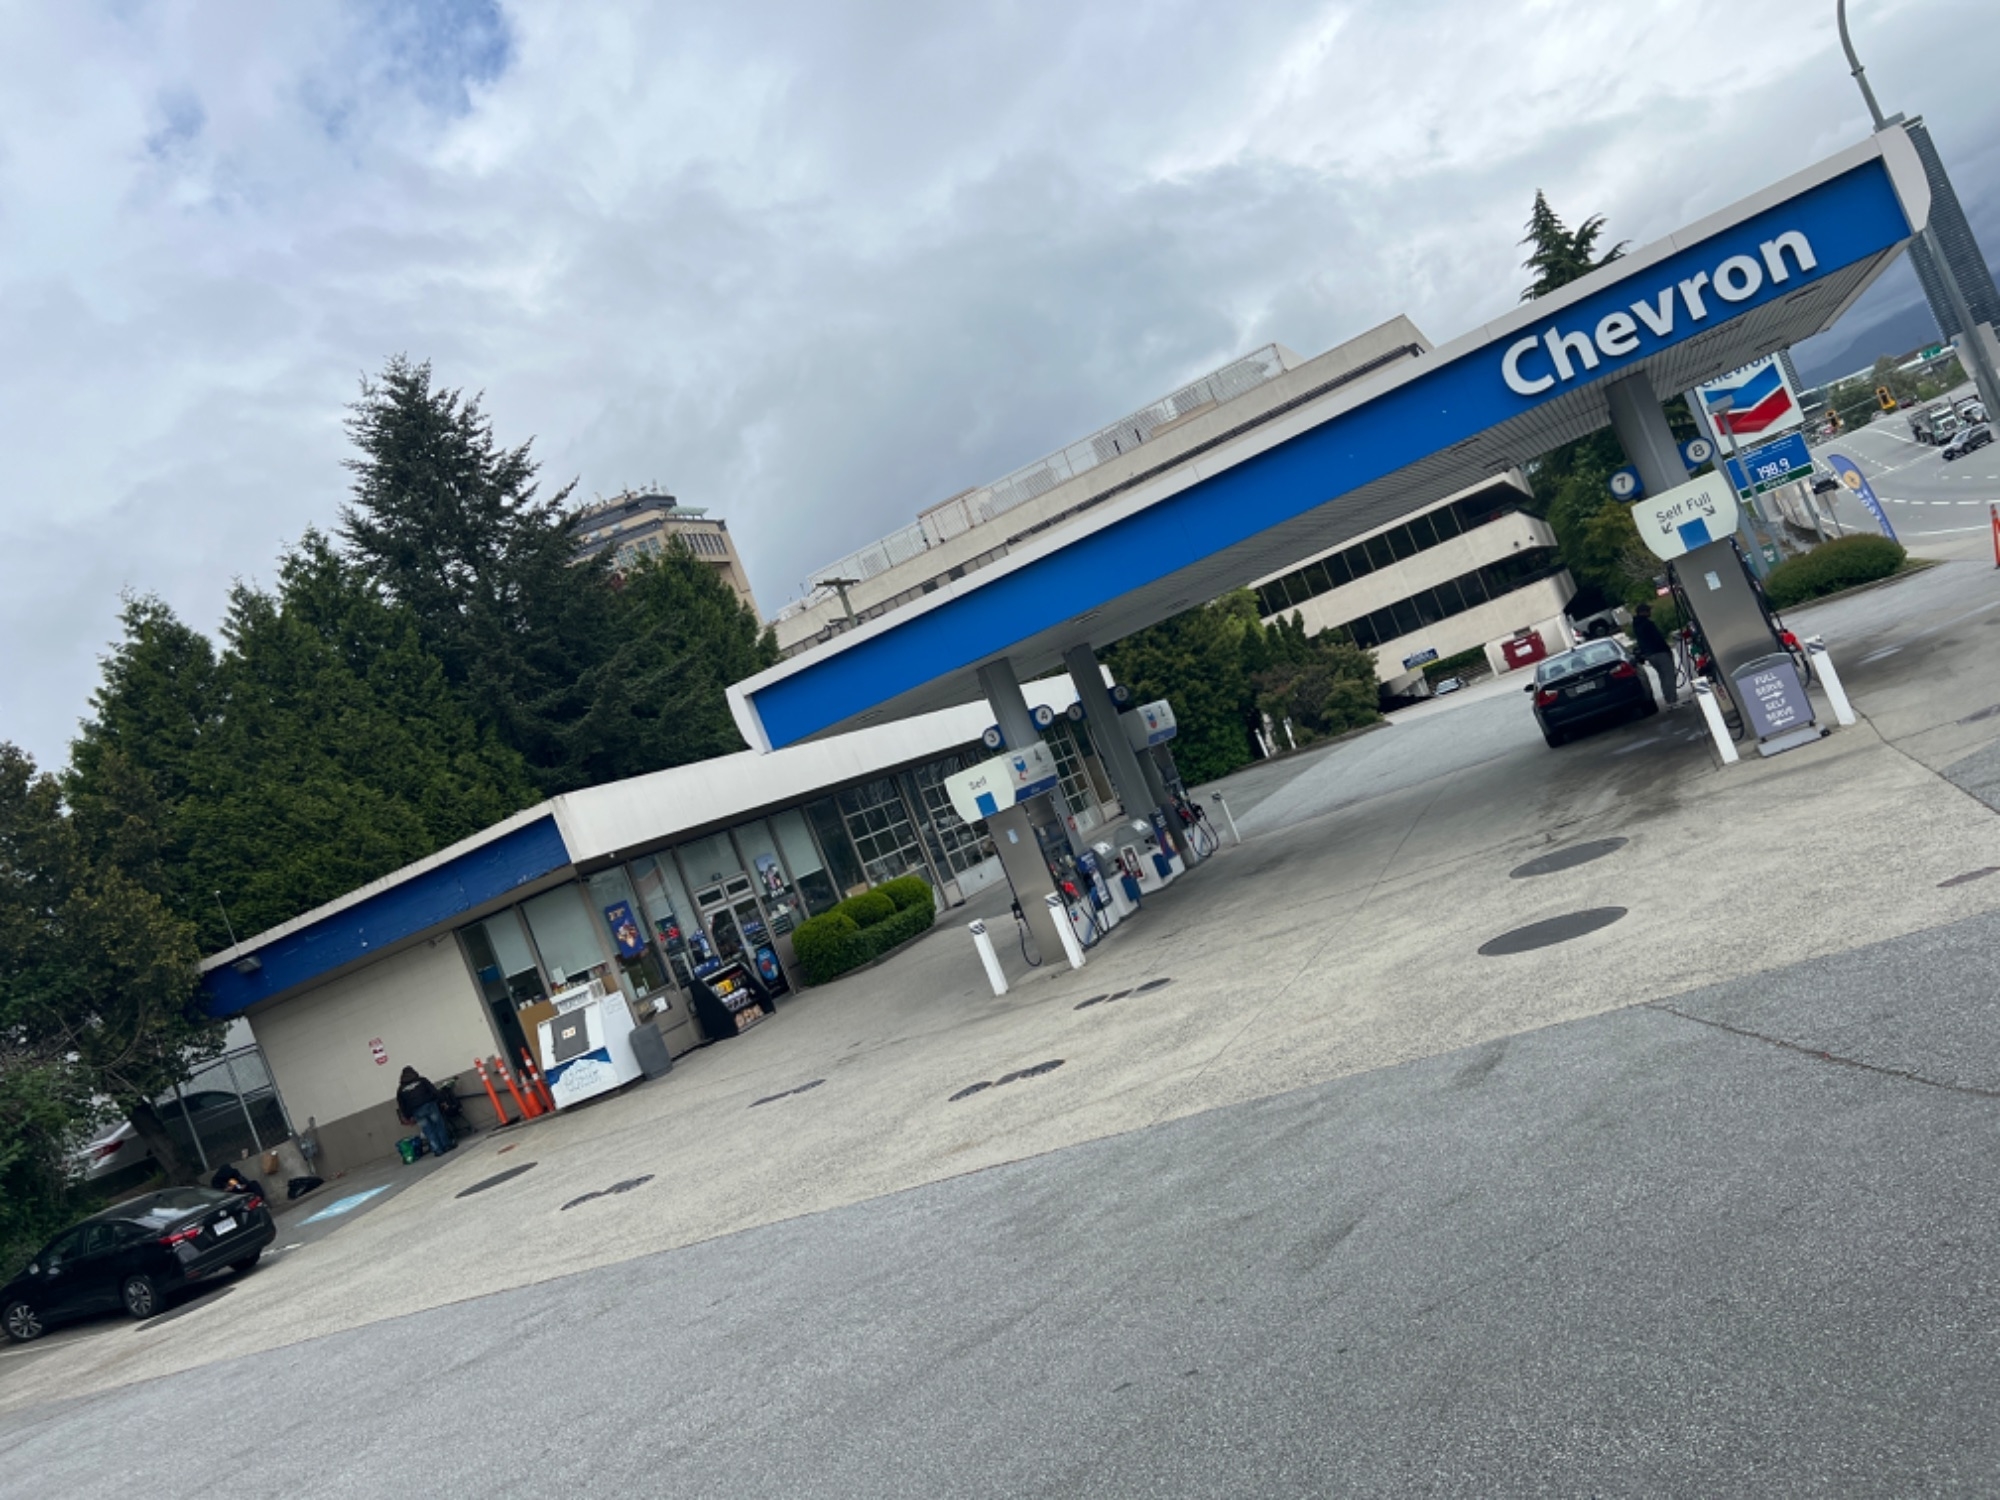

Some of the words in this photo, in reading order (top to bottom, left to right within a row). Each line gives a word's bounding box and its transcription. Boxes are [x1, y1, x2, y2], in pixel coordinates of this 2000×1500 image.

[1501, 230, 1817, 396] Chevron
[1692, 444, 1705, 457] 8
[1757, 458, 1790, 479] 198.9
[1616, 476, 1627, 489] 7
[1656, 503, 1683, 523] Self
[1685, 492, 1712, 510] Full
[1754, 672, 1778, 685] FULL
[1755, 680, 1784, 697] SERVE
[1765, 697, 1786, 711] SELF
[1765, 705, 1795, 722] SERVE
[988, 732, 997, 743] 3
